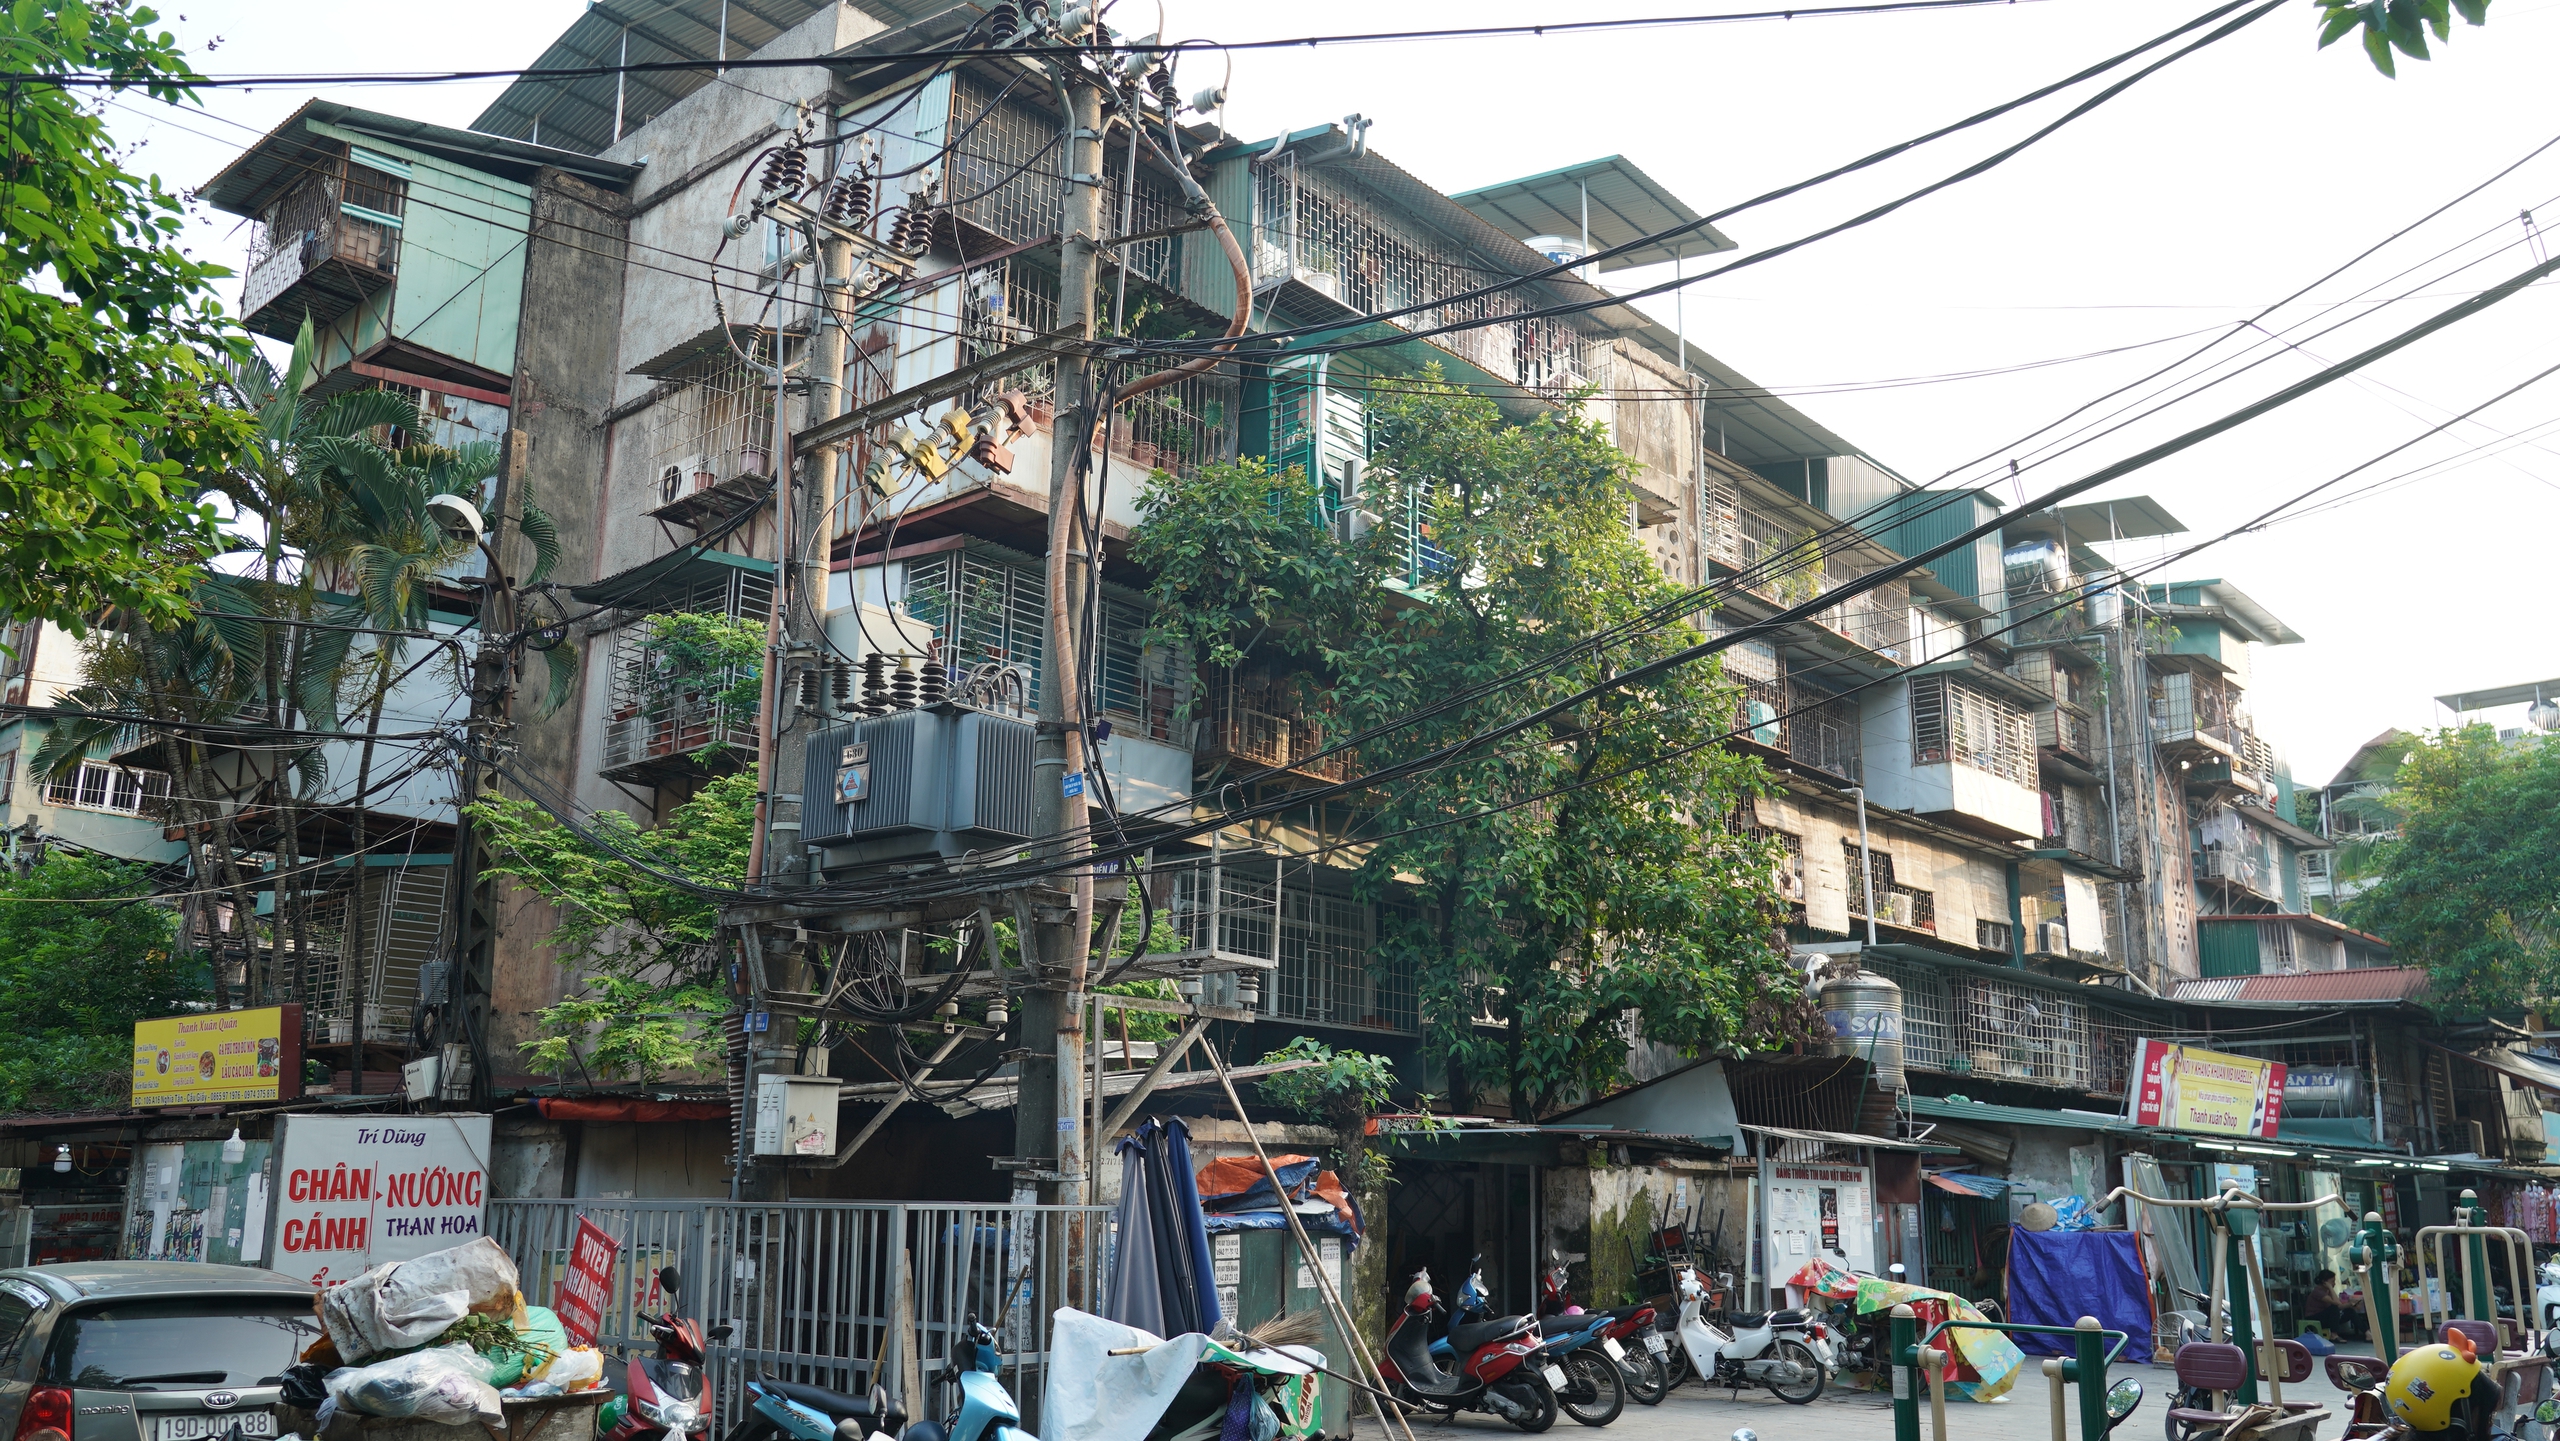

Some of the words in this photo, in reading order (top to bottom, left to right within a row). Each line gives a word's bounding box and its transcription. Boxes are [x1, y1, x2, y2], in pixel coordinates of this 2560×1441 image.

[1108, 862, 1119, 873] ÁP
[178, 1021, 198, 1034] Thanh
[218, 1017, 238, 1032] Quán
[221, 1059, 232, 1079] LẨU
[231, 1063, 242, 1078] CÁC
[242, 1065, 254, 1080] LOẠI
[2189, 1107, 2208, 1123] Thanh
[2208, 1110, 2223, 1126] xuân
[2223, 1112, 2238, 1130] Shop
[357, 1128, 379, 1144] Trí
[382, 1128, 427, 1147] Dũng
[288, 1161, 372, 1203] CHÂN
[1775, 1166, 1791, 1179] BẢNG
[1792, 1166, 1810, 1180] THÔNG
[1810, 1168, 1819, 1180] TIN
[1819, 1169, 1830, 1181] RAO
[1853, 1170, 1863, 1183] PHÍ
[386, 1165, 482, 1209] NƯỚNG
[283, 1211, 368, 1253] CÁNH
[386, 1216, 436, 1237] THAN
[440, 1214, 479, 1235] HOA
[580, 1232, 611, 1278] TUYỂN
[211, 1395, 233, 1405] KIA
[613, 1395, 624, 1411] Grab
[1299, 1374, 1314, 1421] MILO
[78, 1404, 130, 1416] morning
